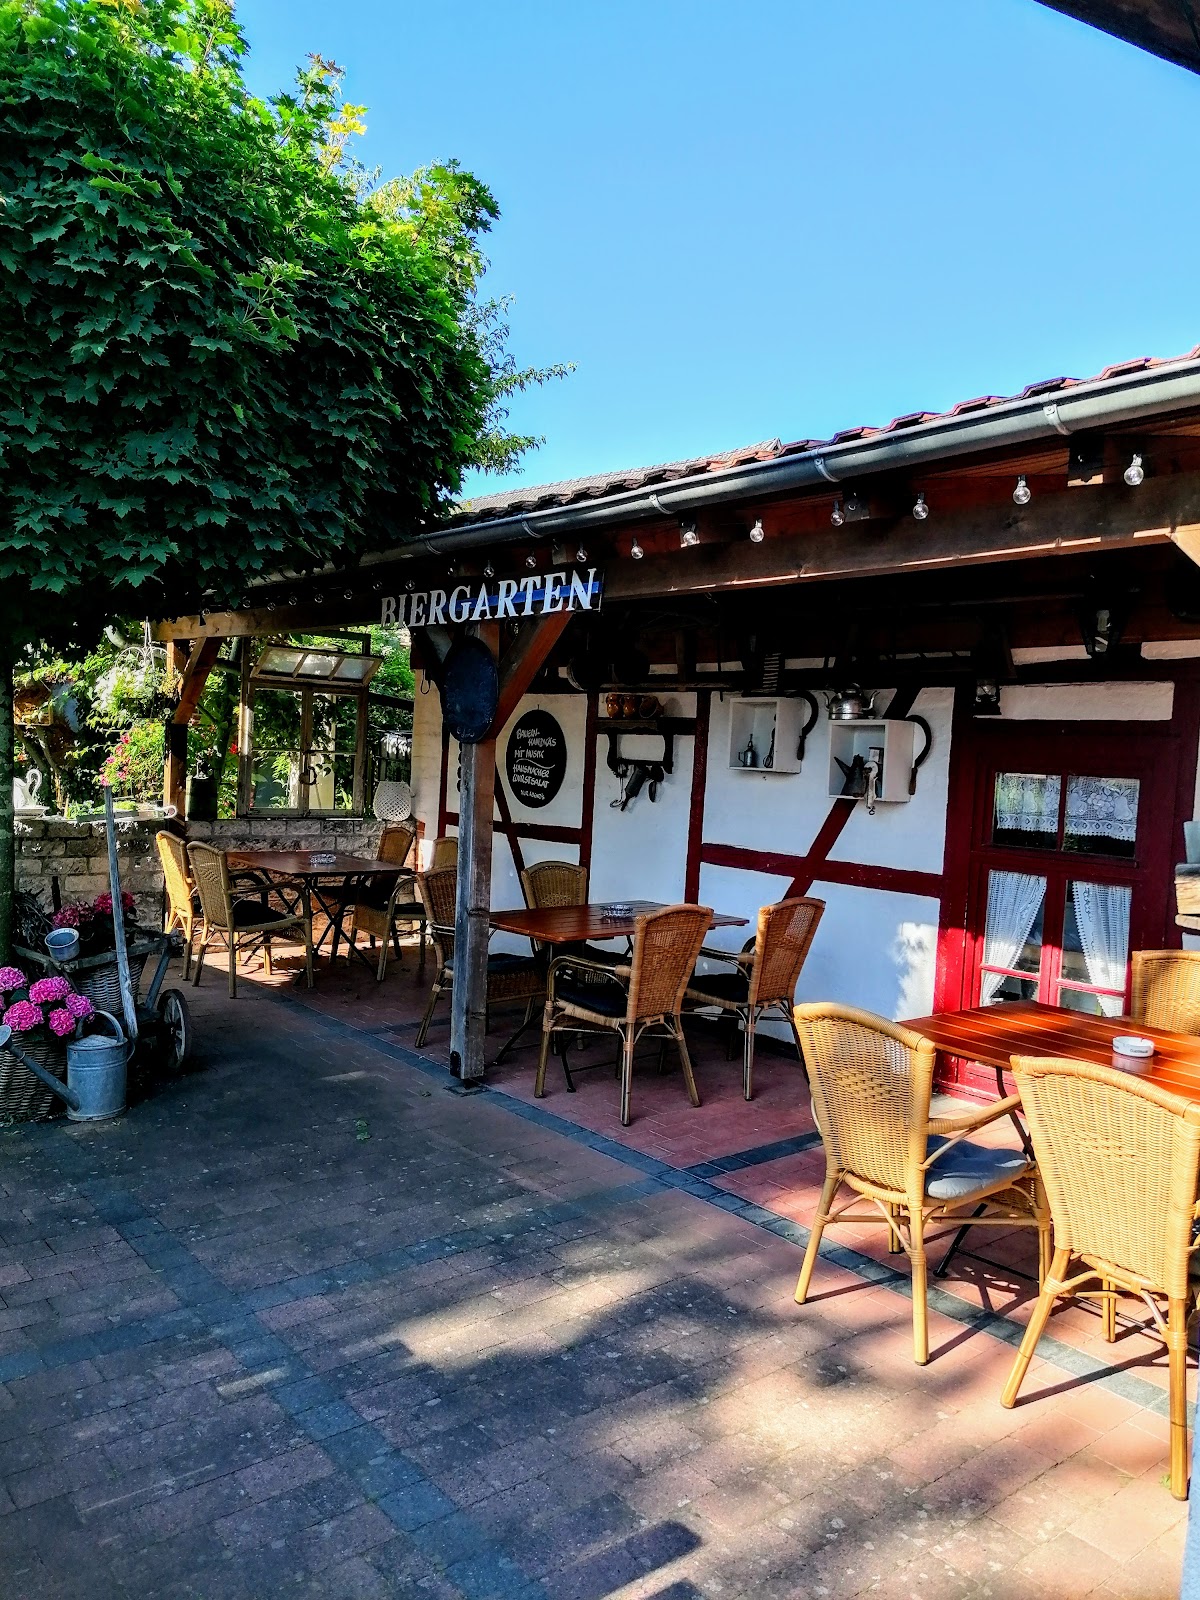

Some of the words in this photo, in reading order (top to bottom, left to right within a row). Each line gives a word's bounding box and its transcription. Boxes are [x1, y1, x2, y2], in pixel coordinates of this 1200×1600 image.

[381, 567, 597, 628] BIERGARTEN
[514, 746, 525, 758] MIT
[526, 748, 545, 759] MUSIK
[512, 764, 550, 778] HAUSMACHER
[512, 773, 550, 789] WURSTSALAT
